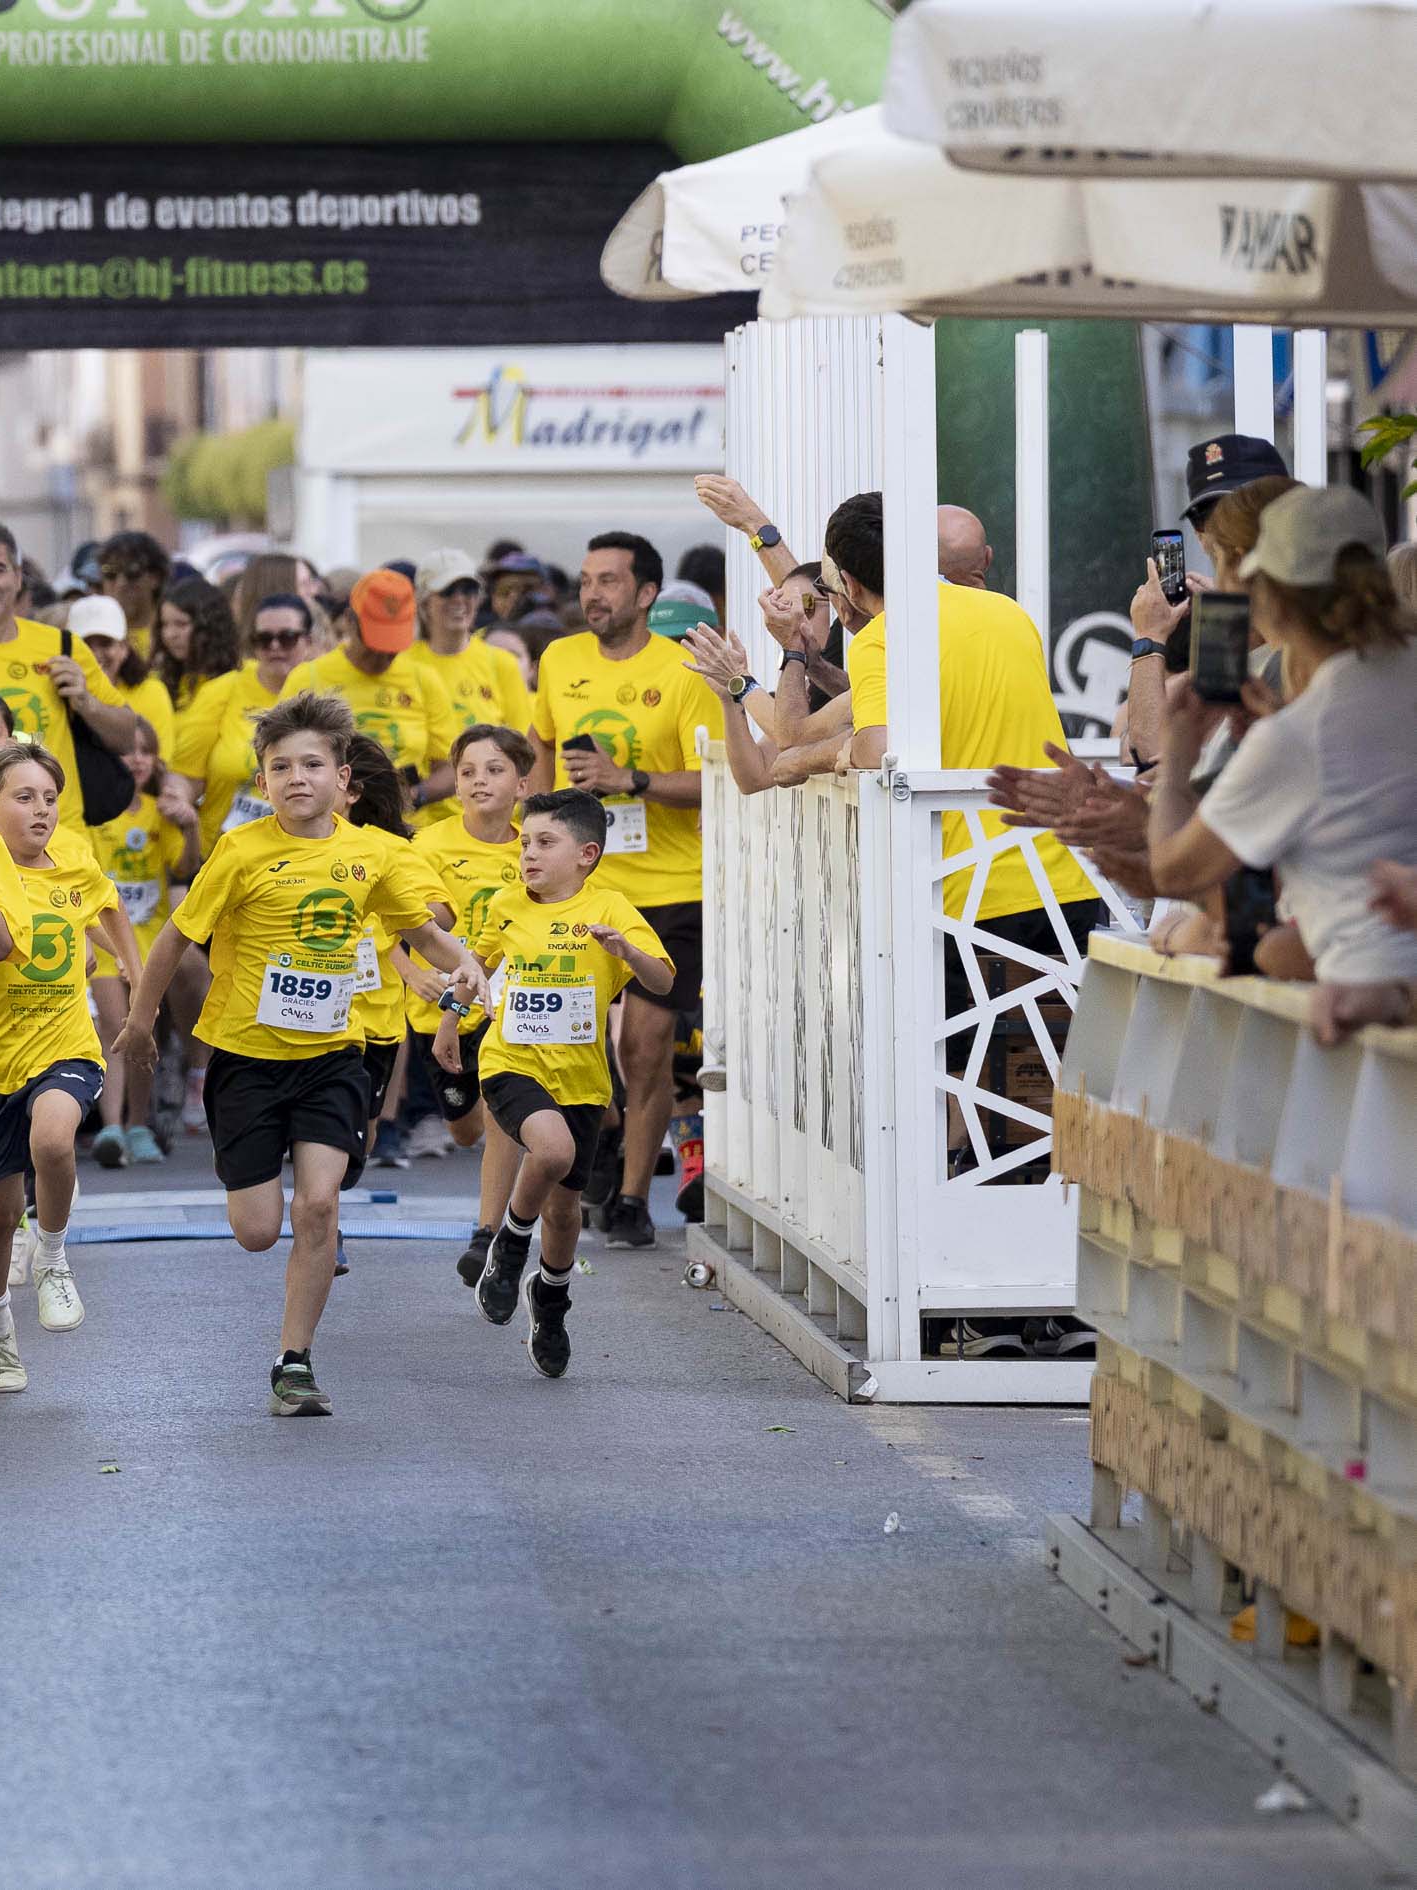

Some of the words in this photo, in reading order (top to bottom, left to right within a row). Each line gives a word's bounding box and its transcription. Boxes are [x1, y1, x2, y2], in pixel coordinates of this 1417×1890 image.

[179, 28, 214, 65] DE
[223, 26, 430, 65] CRONOMETRAJE
[105, 192, 150, 230] de
[155, 192, 291, 230] eventos
[296, 189, 481, 231] deportivos
[454, 366, 706, 458] Madrigal
[295, 959, 323, 969] CELTIC
[270, 972, 332, 1000] 1859
[510, 991, 563, 1013] 1859
